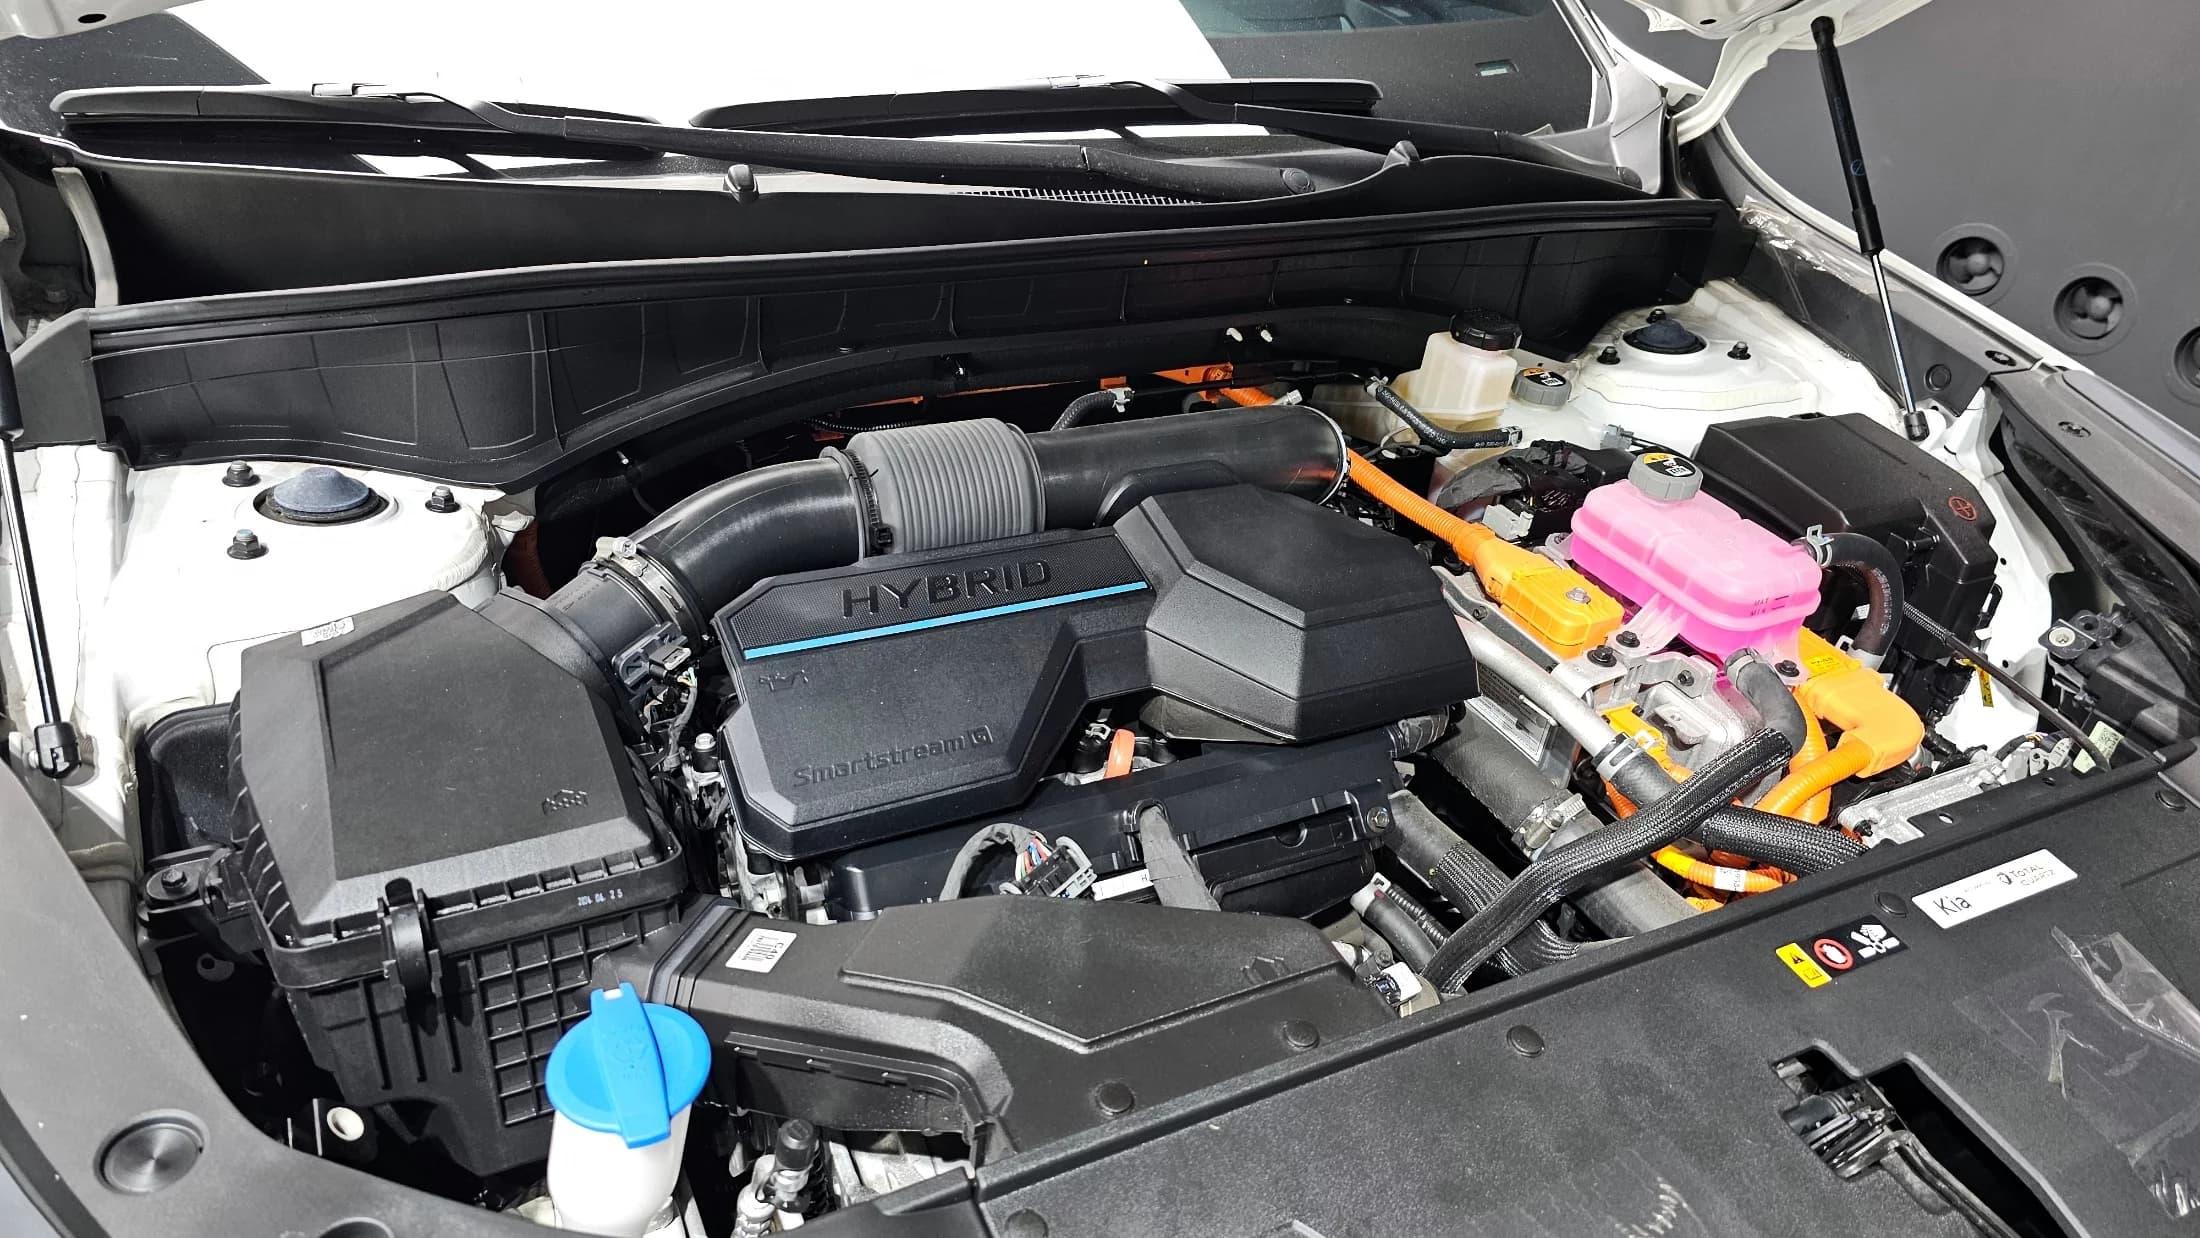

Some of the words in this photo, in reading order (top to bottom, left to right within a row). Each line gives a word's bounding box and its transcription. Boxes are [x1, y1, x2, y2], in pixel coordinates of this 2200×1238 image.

[841, 558, 1053, 619] HYBRID
[793, 733, 966, 788] Smartstream
[2009, 864, 2044, 879] TOTAL
[1933, 893, 1972, 917] Kia
